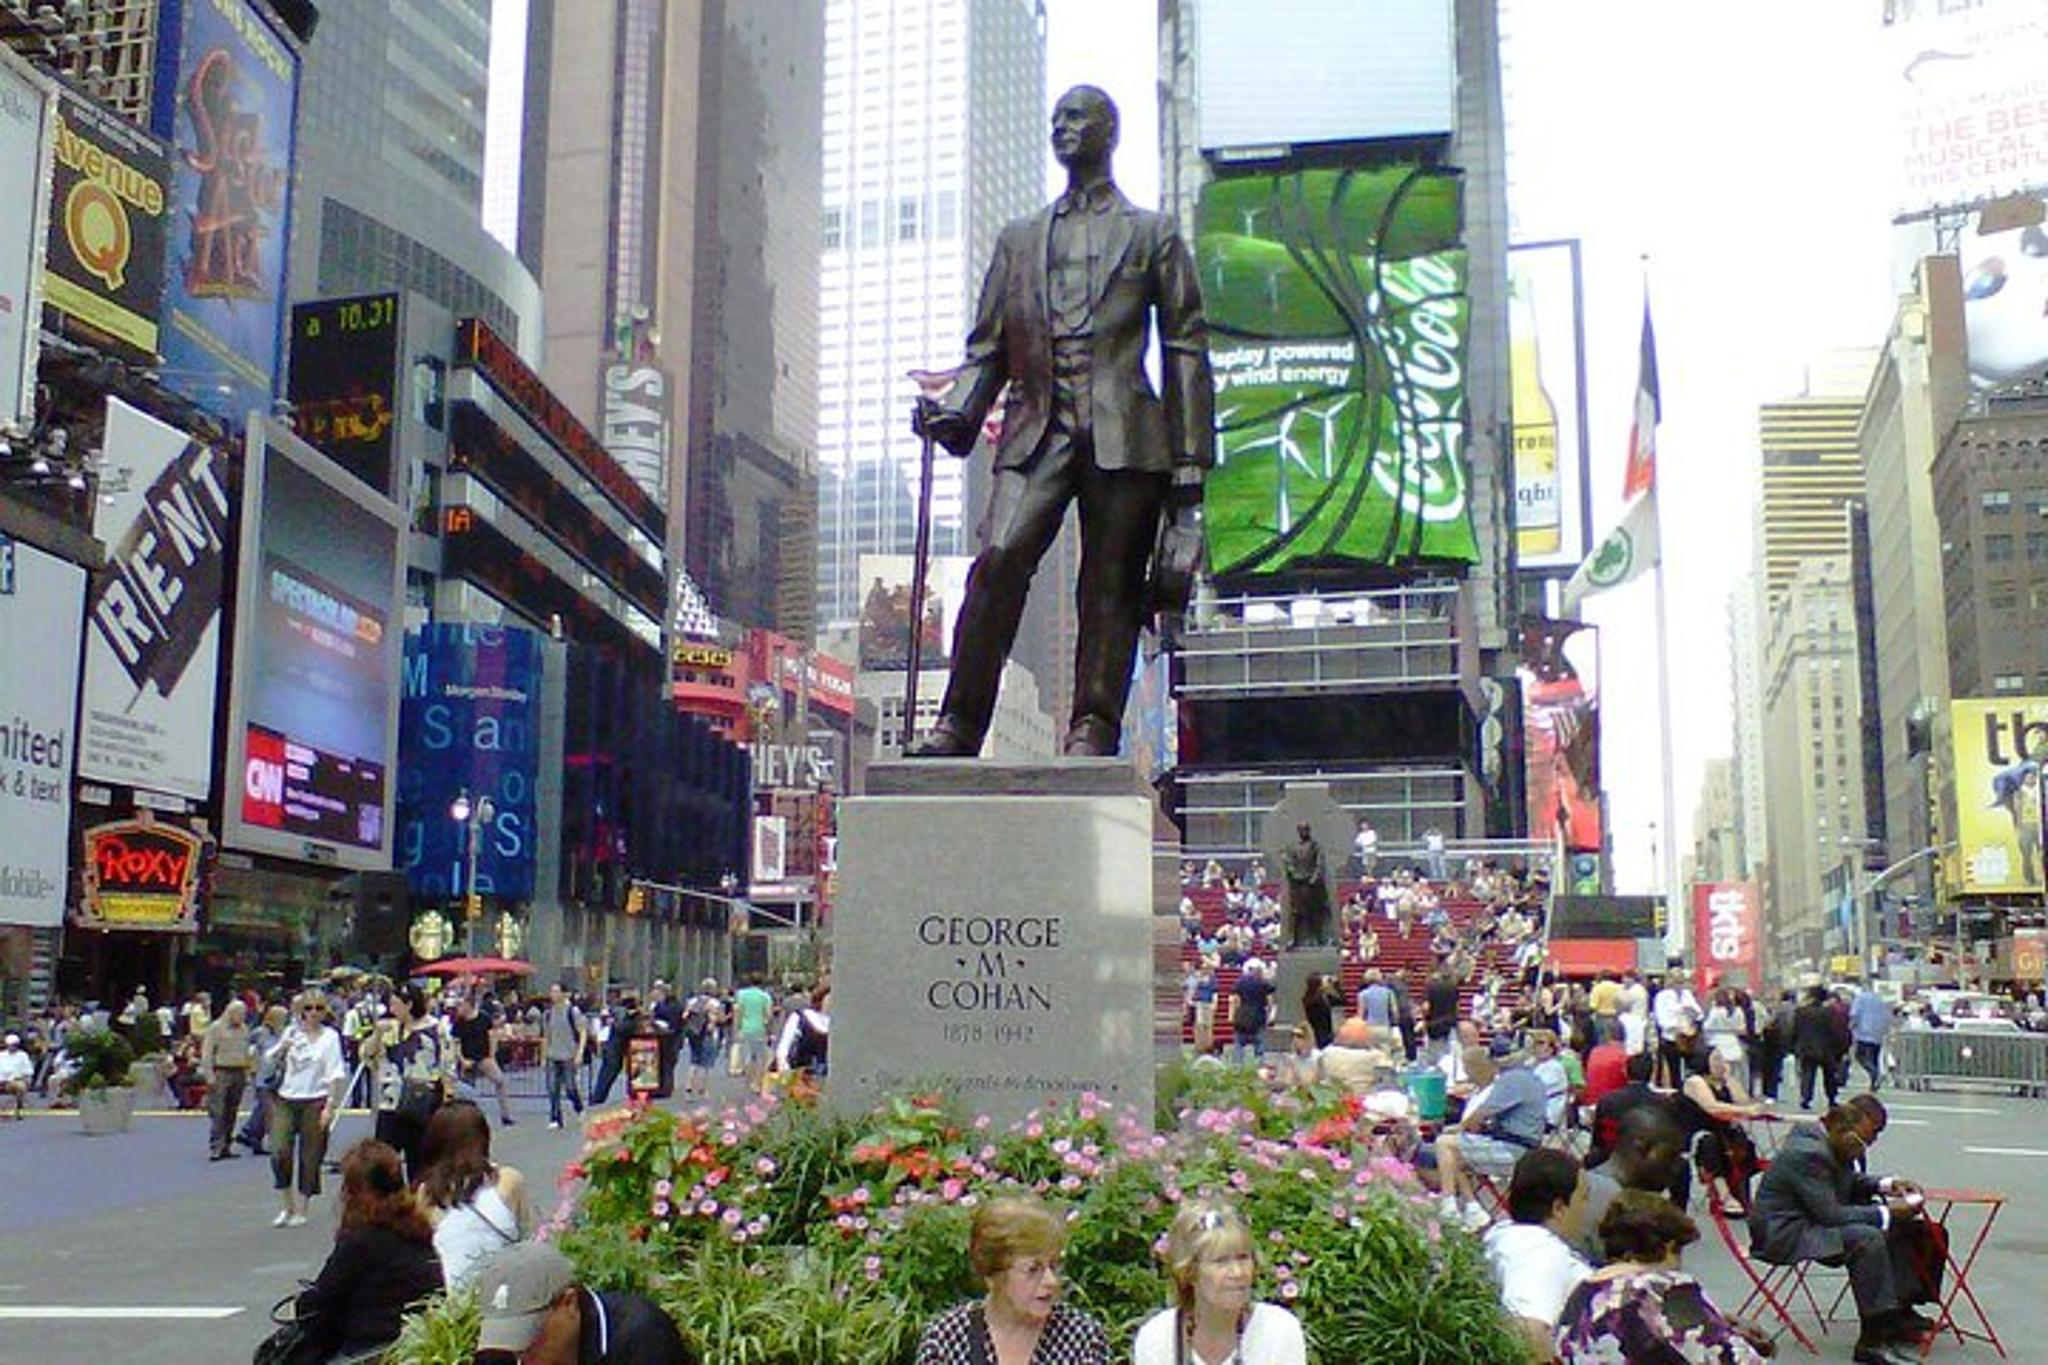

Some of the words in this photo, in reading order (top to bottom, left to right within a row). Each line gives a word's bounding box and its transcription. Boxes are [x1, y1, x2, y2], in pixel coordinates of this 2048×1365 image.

[56, 115, 163, 217] Avenue
[1904, 131, 2034, 170] MUSICAL
[65, 178, 131, 291] Q
[1269, 341, 1355, 364] powered
[1231, 366, 1278, 387] wind
[1281, 365, 1350, 387] energy
[96, 446, 230, 665] RENT
[919, 915, 1061, 948] GEORGE
[1709, 891, 1747, 961] tkts
[928, 980, 1052, 1011] COHAN
